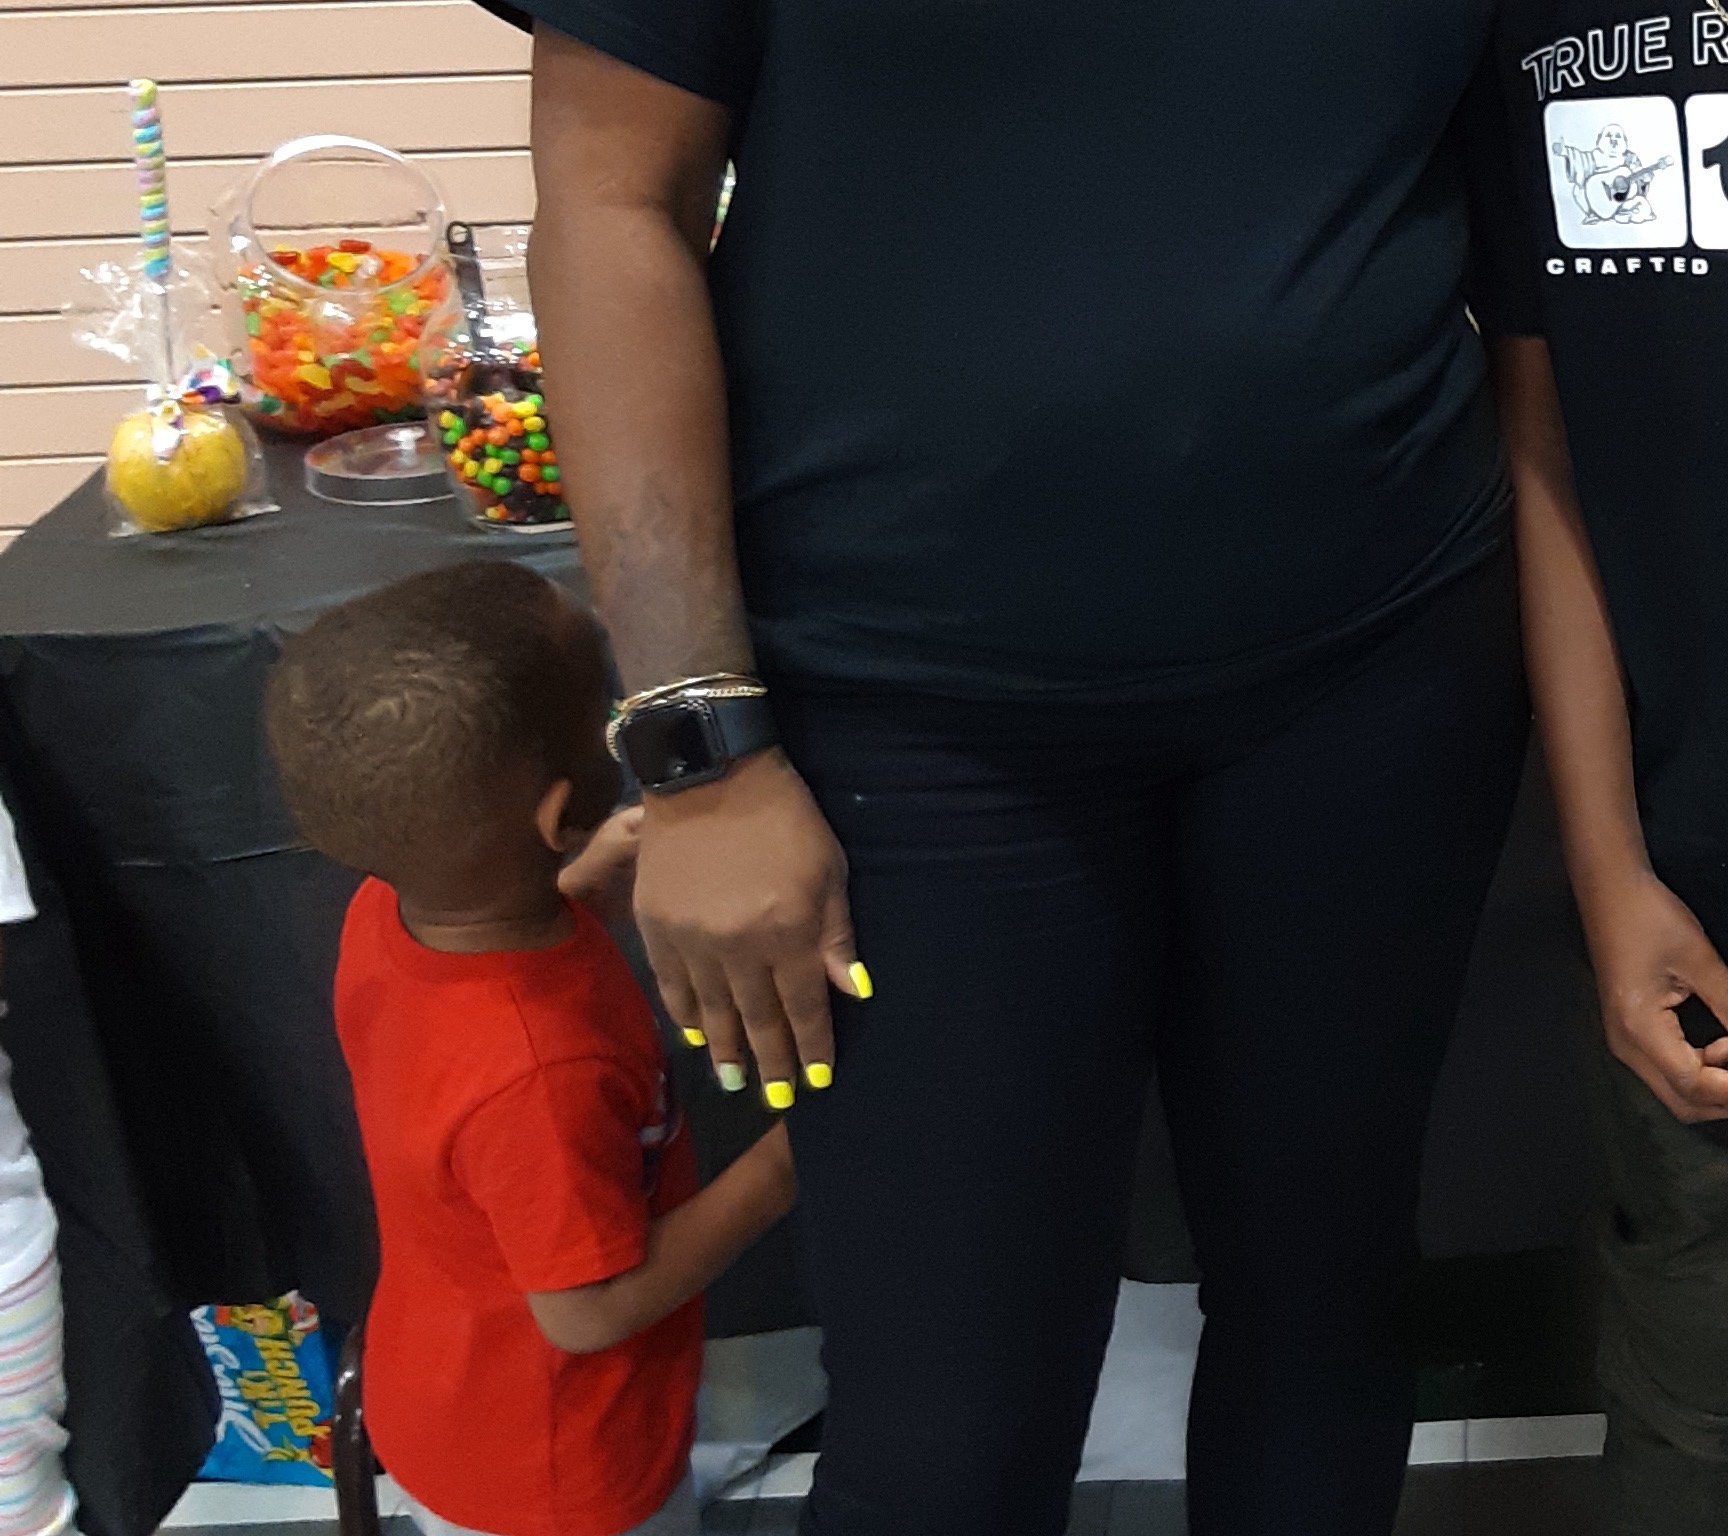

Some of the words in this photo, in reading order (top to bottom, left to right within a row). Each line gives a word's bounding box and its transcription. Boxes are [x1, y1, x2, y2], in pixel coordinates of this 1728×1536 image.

[1522, 16, 1673, 101] TRUE
[1546, 257, 1708, 275] CRAFTED
[253, 1338, 332, 1437] PUNCH
